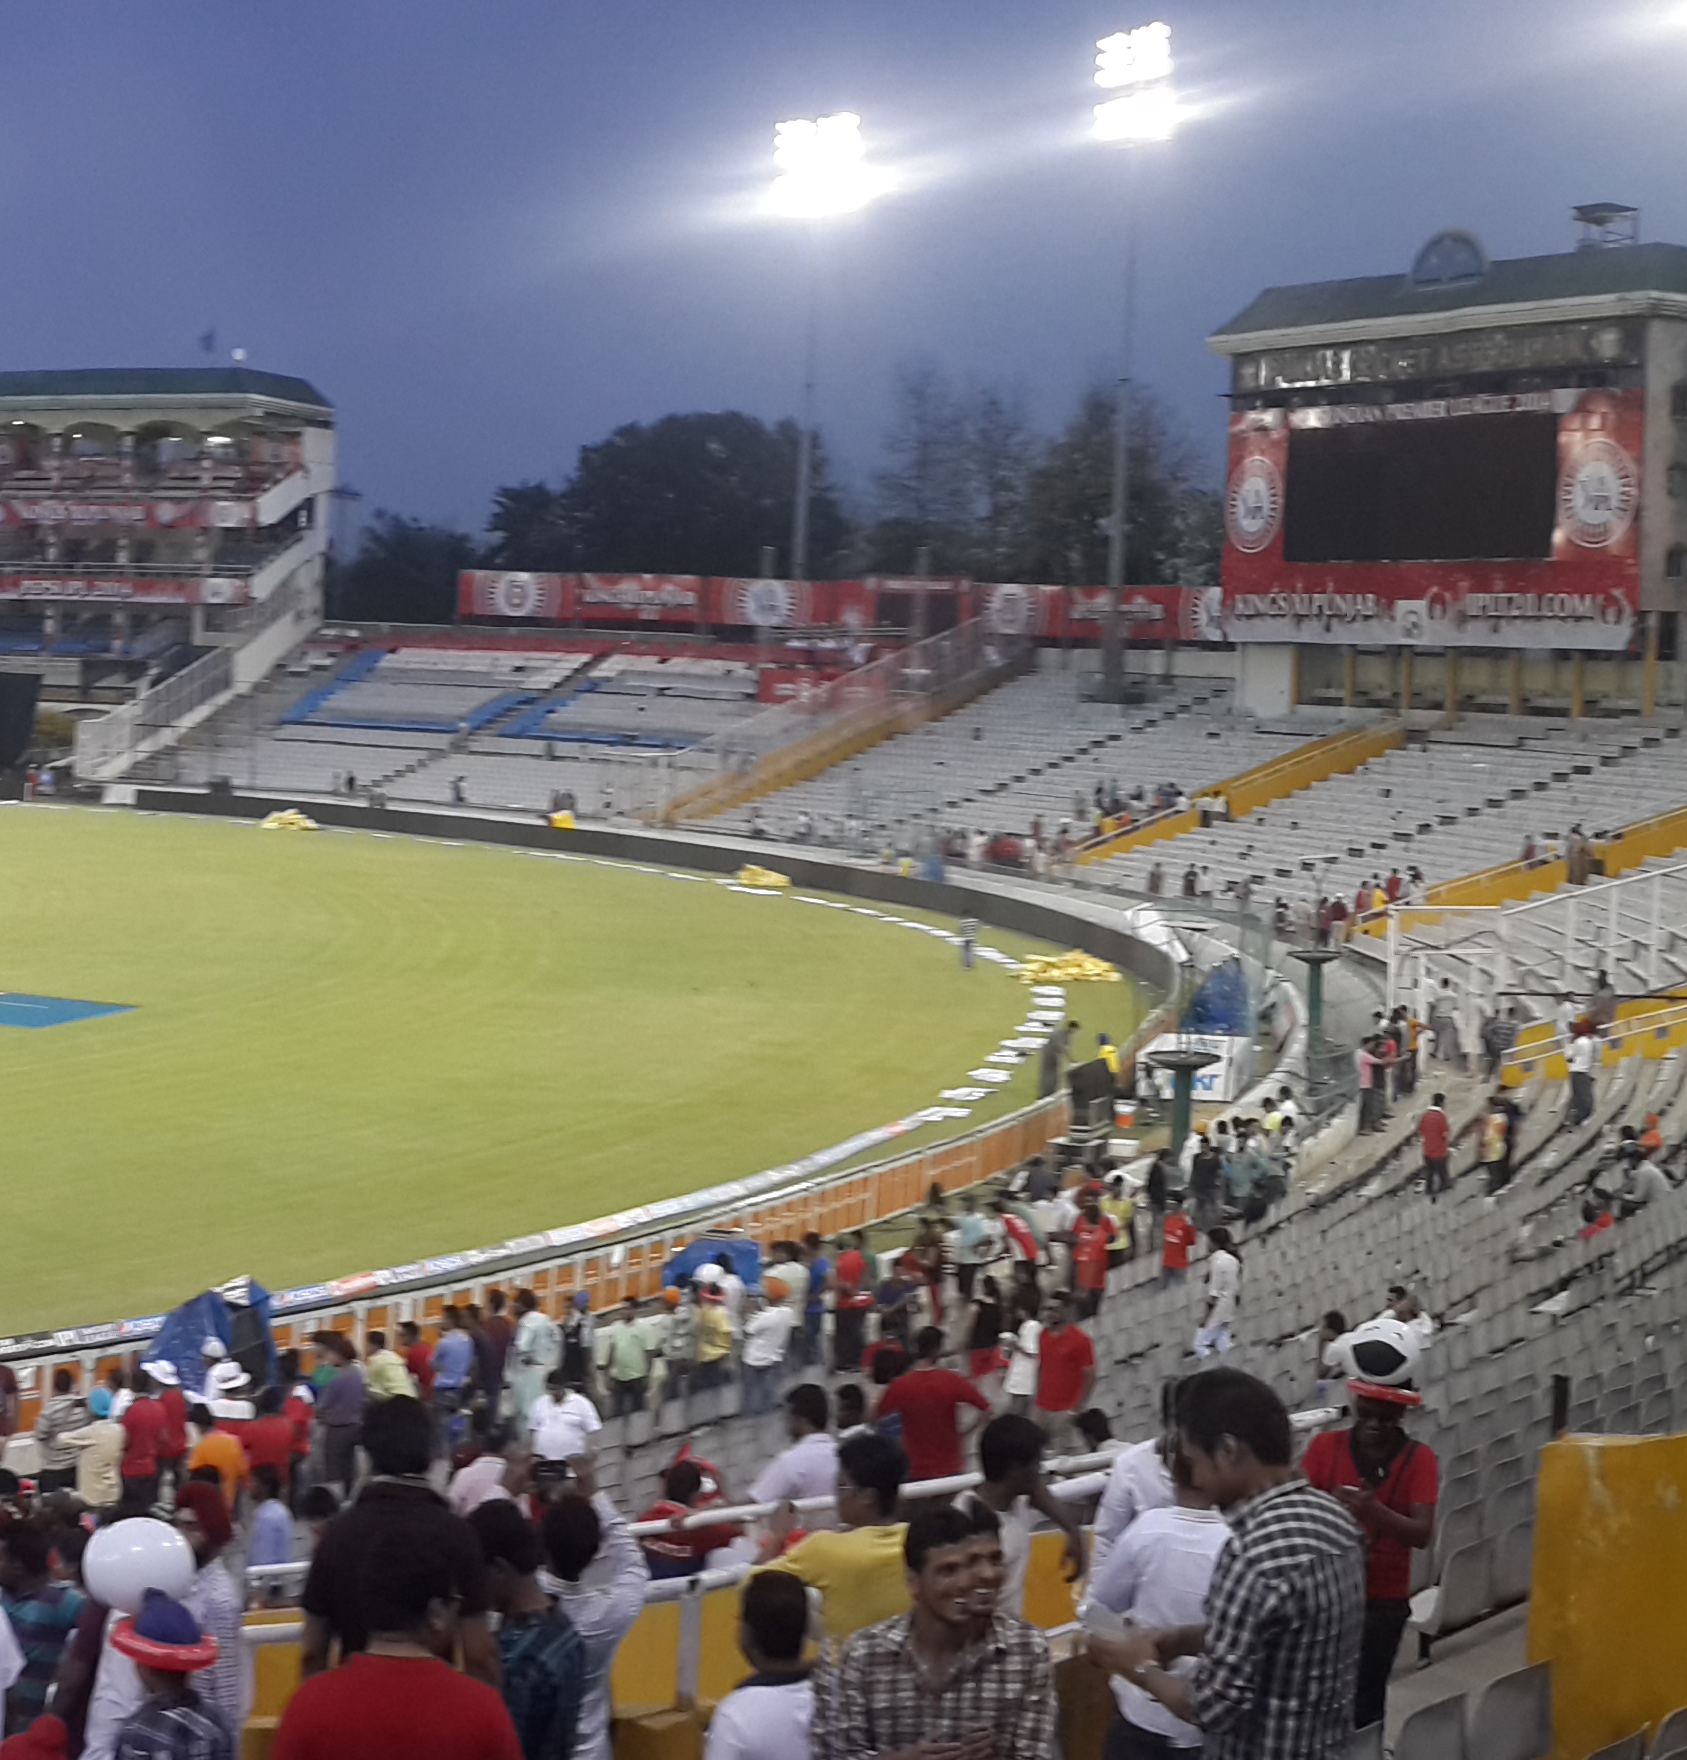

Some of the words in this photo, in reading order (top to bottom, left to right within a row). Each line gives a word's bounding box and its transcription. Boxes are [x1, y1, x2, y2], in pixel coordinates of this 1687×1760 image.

[1234, 592, 1289, 617] KINGS
[1313, 592, 1378, 623] PUNJAB
[1467, 592, 1593, 619] IPLT20.COM
